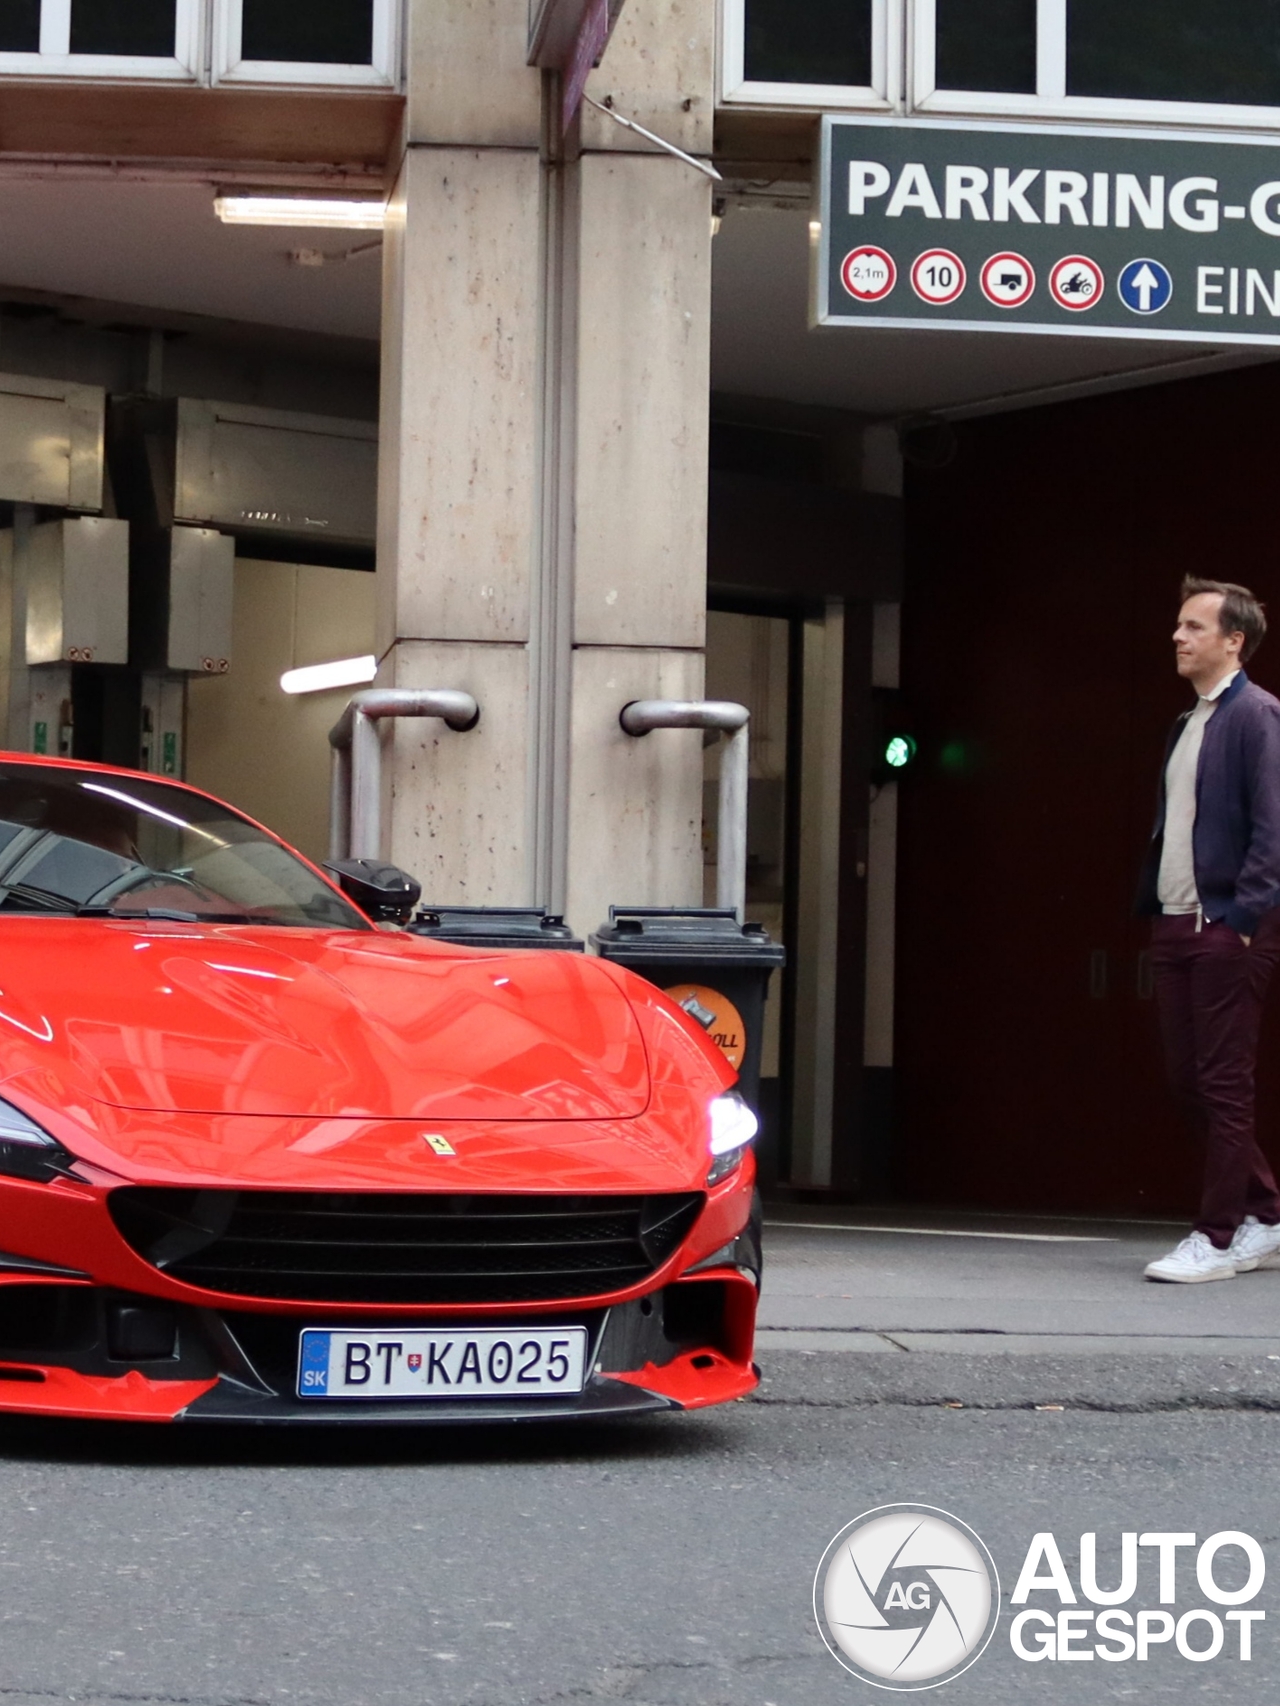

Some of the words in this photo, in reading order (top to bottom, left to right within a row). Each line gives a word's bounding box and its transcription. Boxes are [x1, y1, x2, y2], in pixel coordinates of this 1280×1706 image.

[848, 160, 1280, 237] PARKRING-G
[852, 266, 885, 279] 2,1m
[926, 265, 953, 287] 10
[1197, 265, 1280, 317] EIN
[708, 1033, 739, 1048] OLL
[344, 1341, 403, 1386] BT
[426, 1340, 570, 1385] KA025
[303, 1370, 326, 1386] SK
